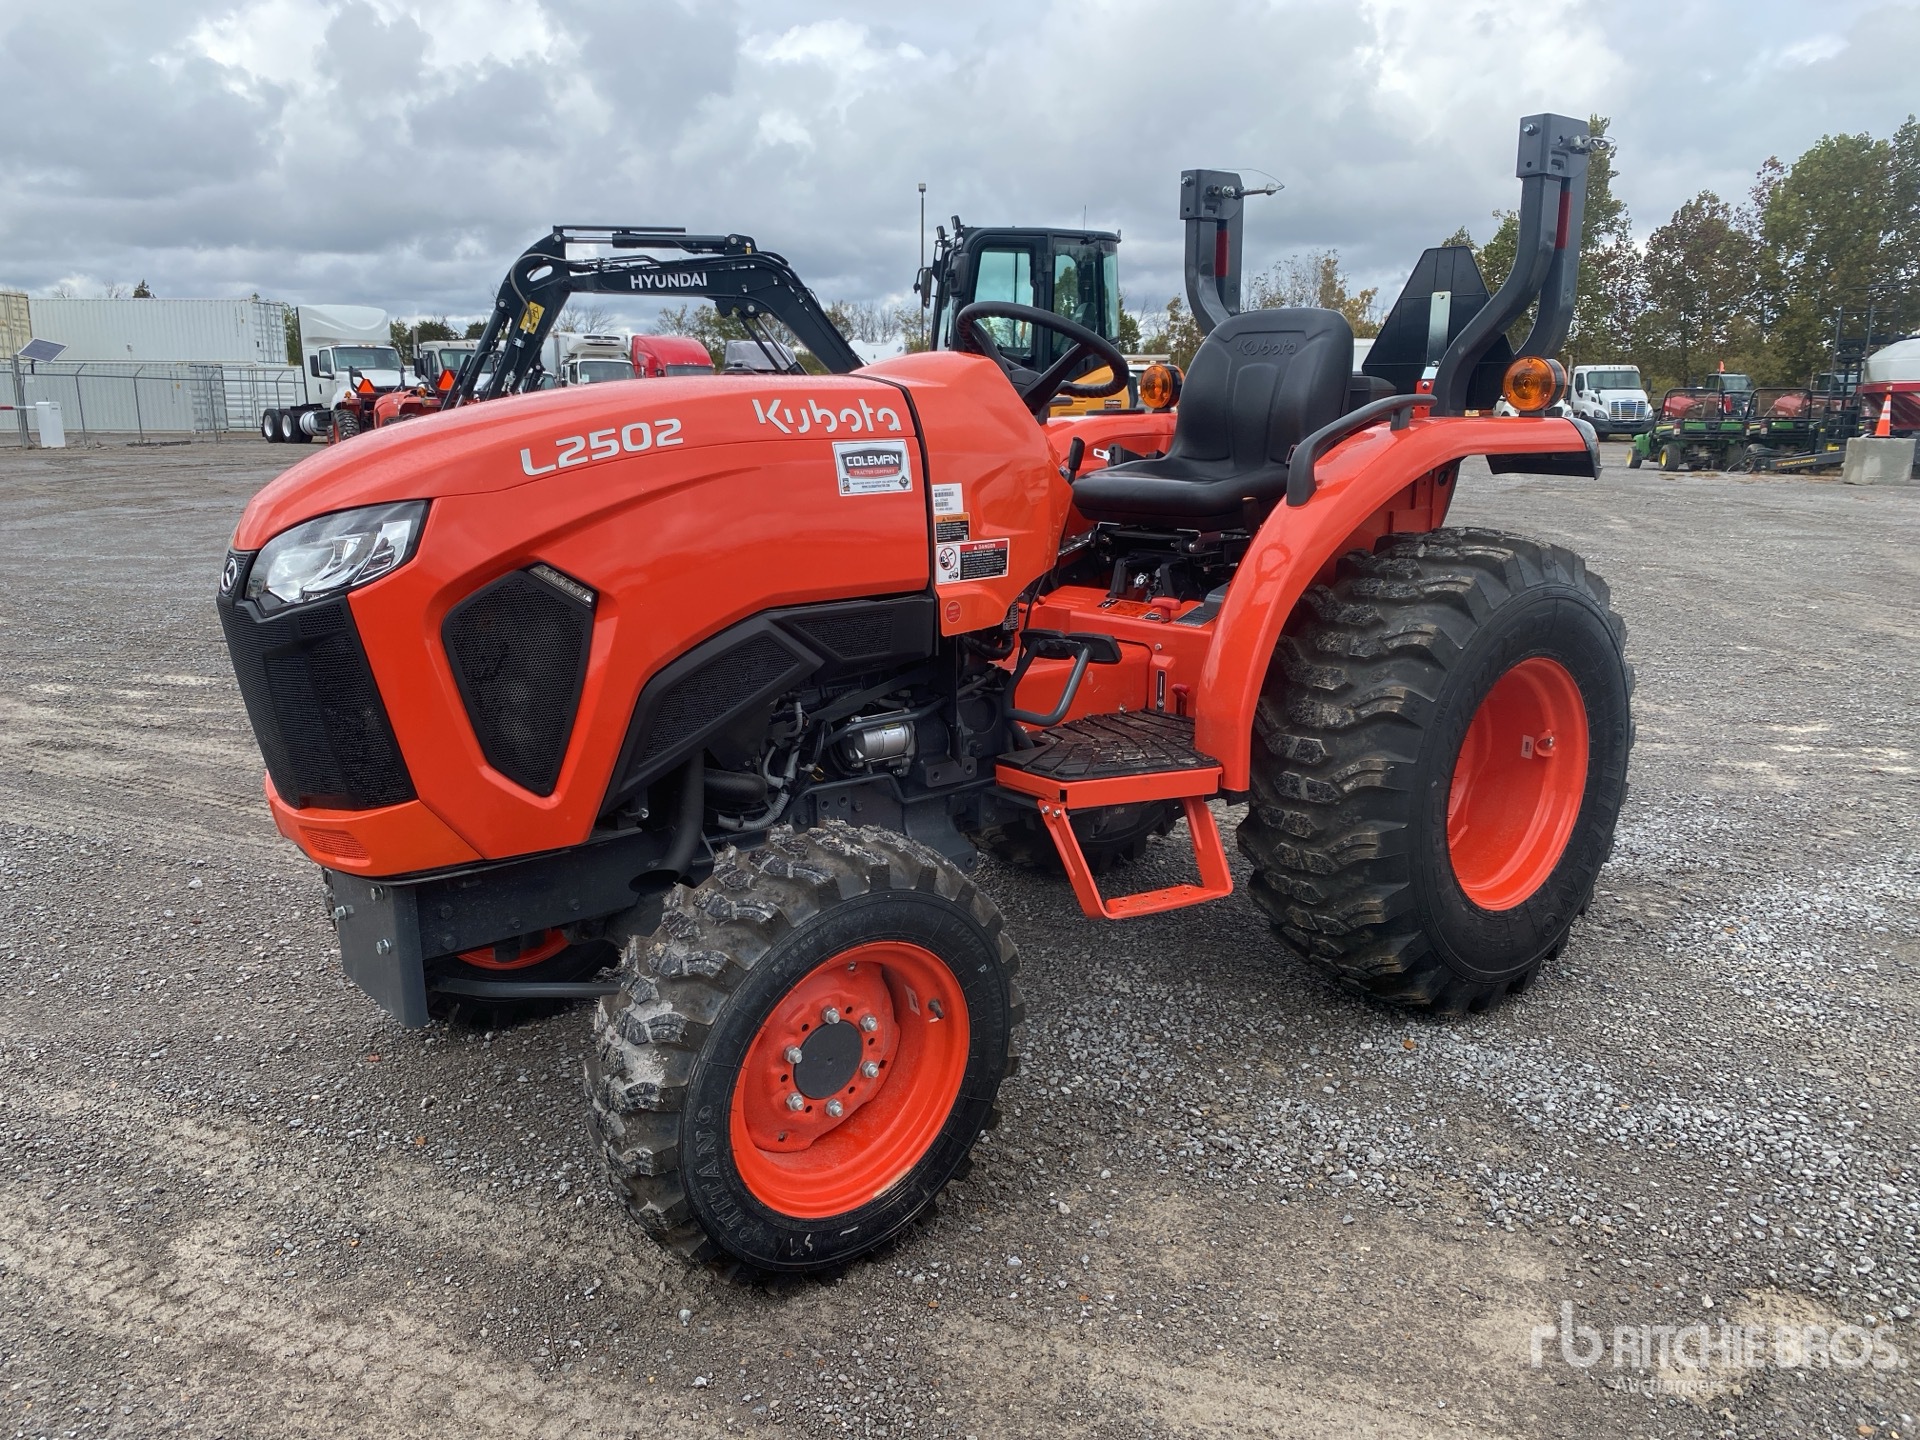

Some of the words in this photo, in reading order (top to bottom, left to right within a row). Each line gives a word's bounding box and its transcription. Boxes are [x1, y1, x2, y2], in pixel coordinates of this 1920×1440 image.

[630, 272, 708, 290] HYUNDAI
[1236, 338, 1297, 356] Kubota
[752, 398, 902, 434] Kubota
[519, 418, 684, 476] L2502
[846, 454, 900, 467] COLEMAN
[695, 1130, 745, 1231] TITAN
